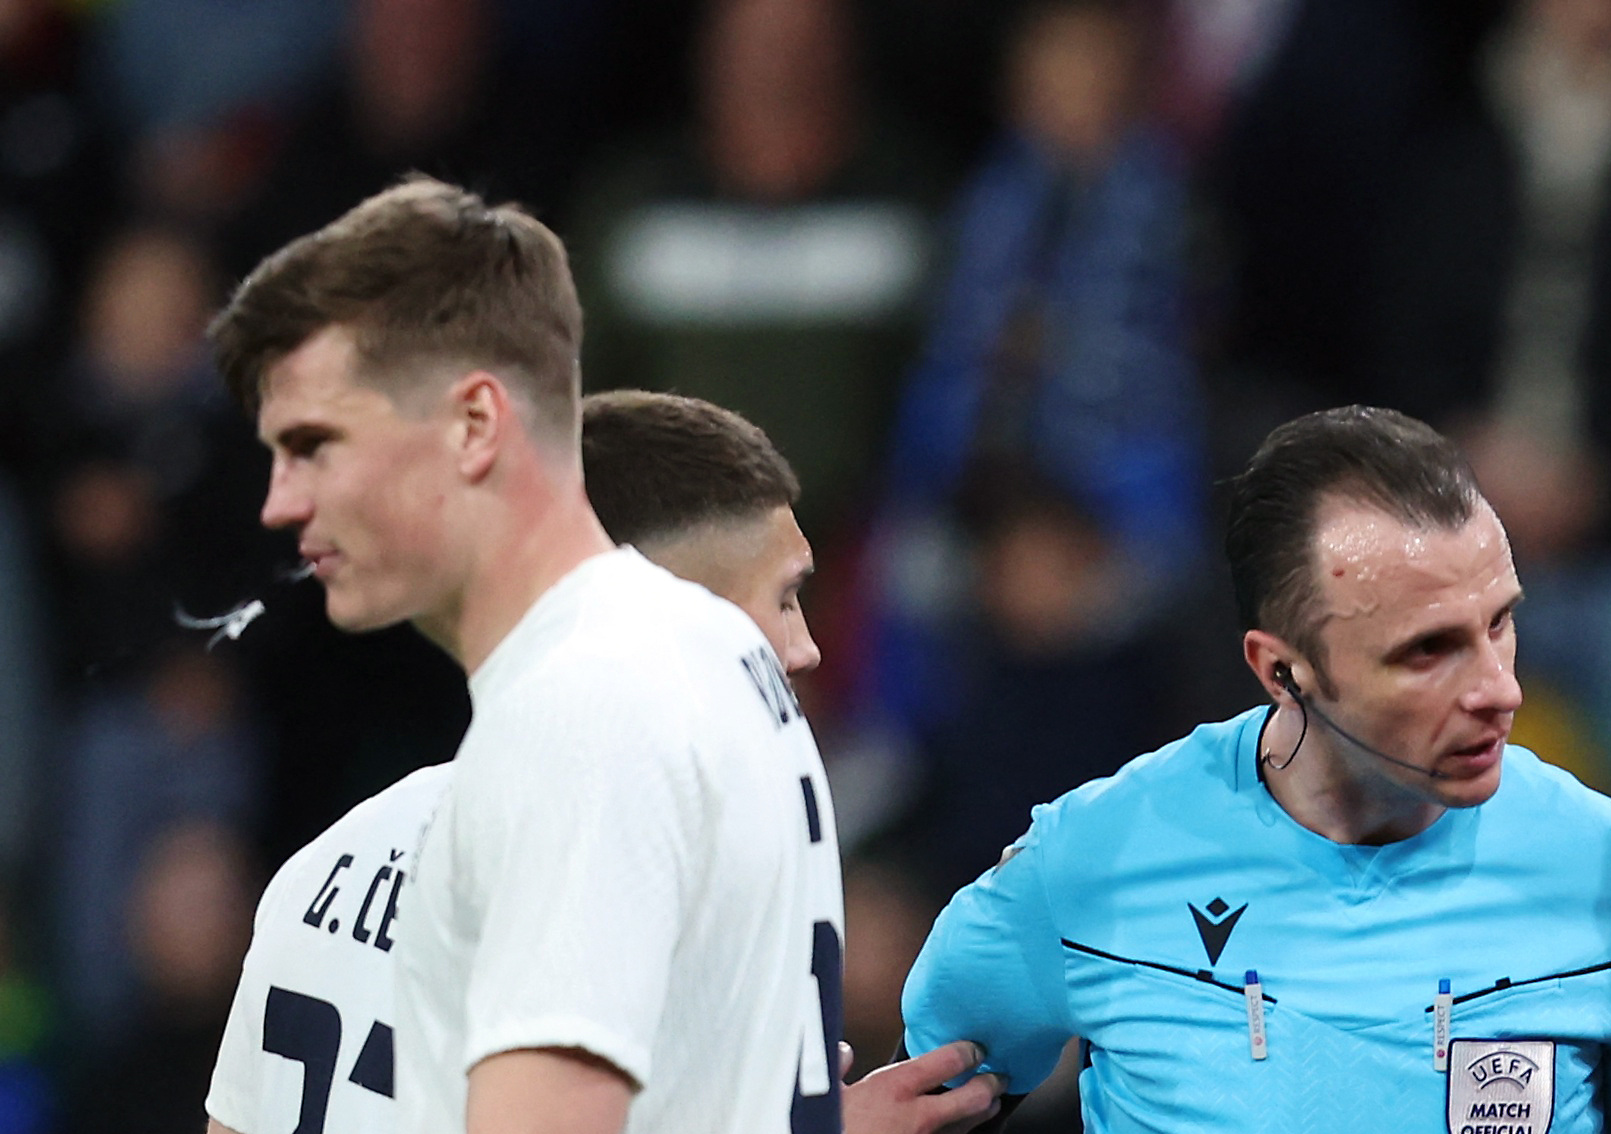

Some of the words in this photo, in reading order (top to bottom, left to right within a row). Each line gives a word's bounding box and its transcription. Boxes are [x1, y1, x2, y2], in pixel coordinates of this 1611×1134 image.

[303, 853, 354, 934] G.
[1437, 1005, 1446, 1046] RESPECT
[1472, 1057, 1534, 1084] UEFA
[1469, 1103, 1531, 1119] MATCH
